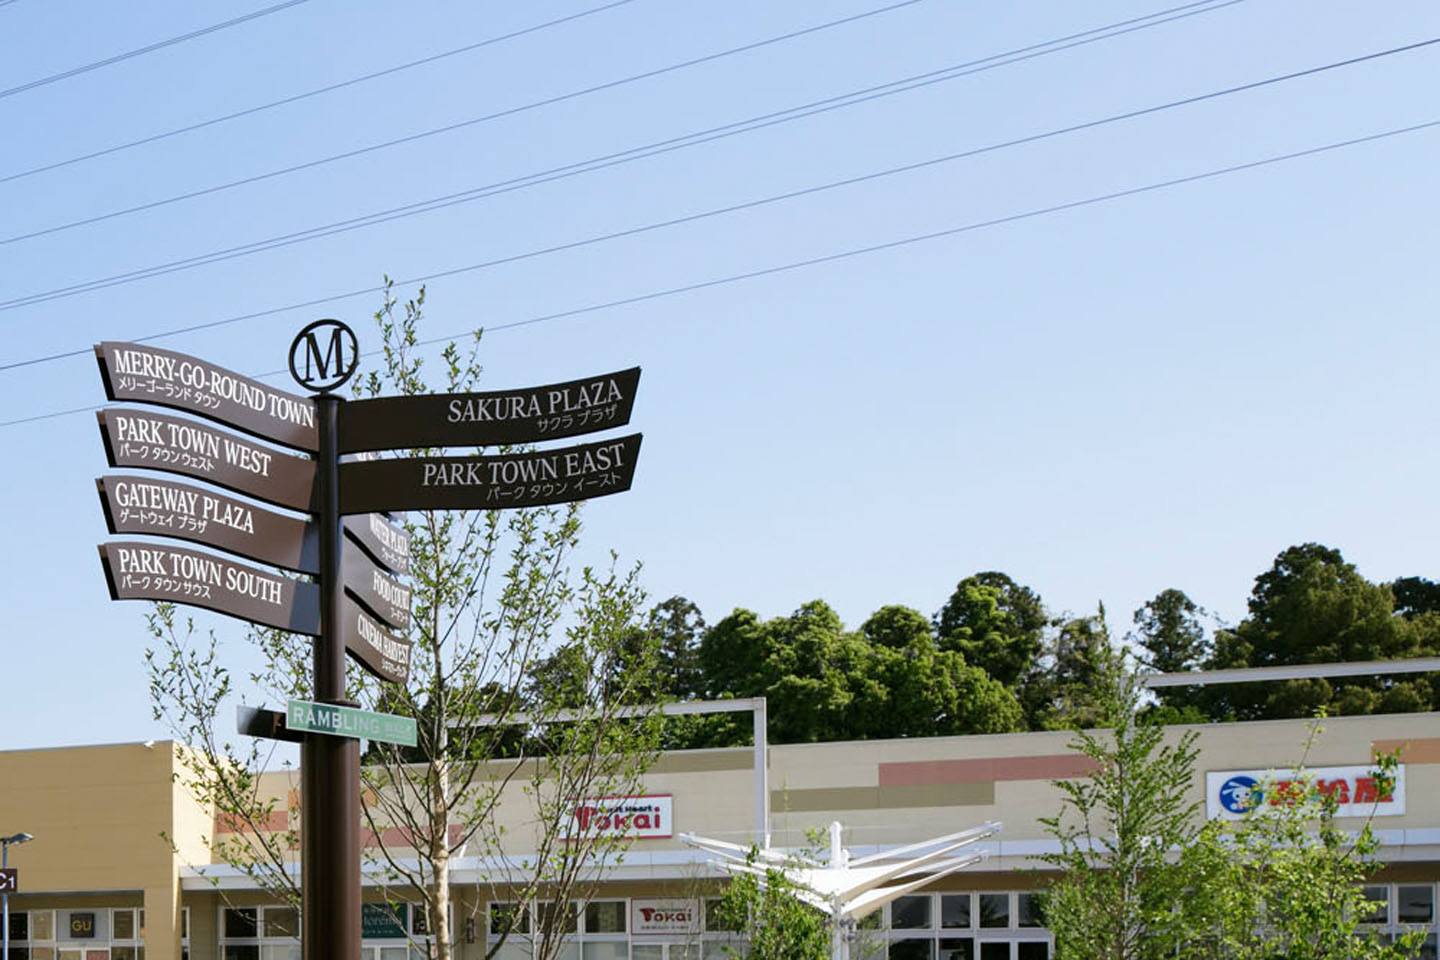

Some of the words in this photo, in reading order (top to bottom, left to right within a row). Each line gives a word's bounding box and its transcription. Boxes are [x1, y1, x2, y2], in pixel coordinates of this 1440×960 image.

[113, 349, 265, 412] MERRY-GO-ROUND
[268, 394, 314, 428] TOWN
[118, 376, 191, 400] メリーゴーランド
[194, 391, 221, 409] タウン
[447, 394, 542, 423] SAKURA
[547, 379, 623, 415] PLAZA
[537, 415, 574, 433] サクラ
[578, 404, 618, 427] プラザ
[116, 416, 165, 445] PARK
[168, 423, 220, 458] TOWN
[223, 439, 272, 476] WEST
[119, 443, 149, 457] パーク
[422, 462, 483, 486] PARK
[488, 456, 558, 485] TOWN
[563, 443, 625, 478] EAST
[486, 486, 525, 501] パーク
[529, 482, 568, 498] タウン
[573, 471, 622, 492] イースト
[115, 482, 198, 516] GATEWAY
[203, 496, 254, 534] PLAZA
[119, 508, 174, 525] ゲートウェイ
[177, 515, 208, 534] プラザ
[118, 548, 167, 576] PARK
[169, 553, 223, 587] TOWN
[225, 567, 283, 605] SOUTH
[121, 574, 150, 589] パーク
[373, 570, 391, 602] FOOD
[358, 614, 382, 653] CINEMA
[293, 706, 380, 734] RAMBLING
[576, 806, 661, 831] Tokai
[71, 920, 92, 932] GU
[639, 907, 692, 922] Tokai
